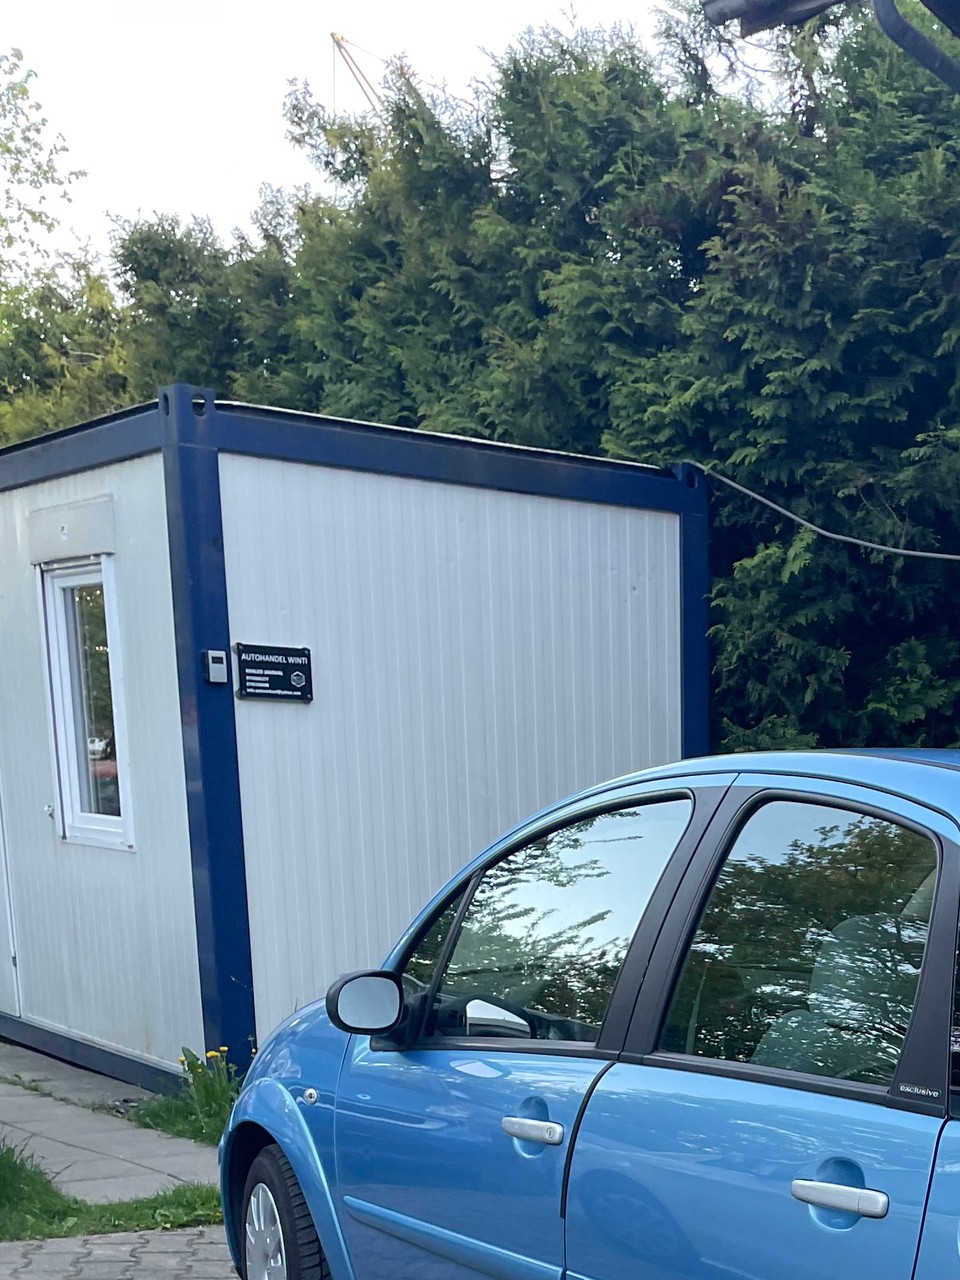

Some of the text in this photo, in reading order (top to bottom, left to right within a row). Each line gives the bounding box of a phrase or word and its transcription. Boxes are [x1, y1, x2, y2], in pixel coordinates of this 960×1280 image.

[241, 653, 308, 665] AUTOHANDEL WINTI
[900, 1085, 939, 1098] exclusive
